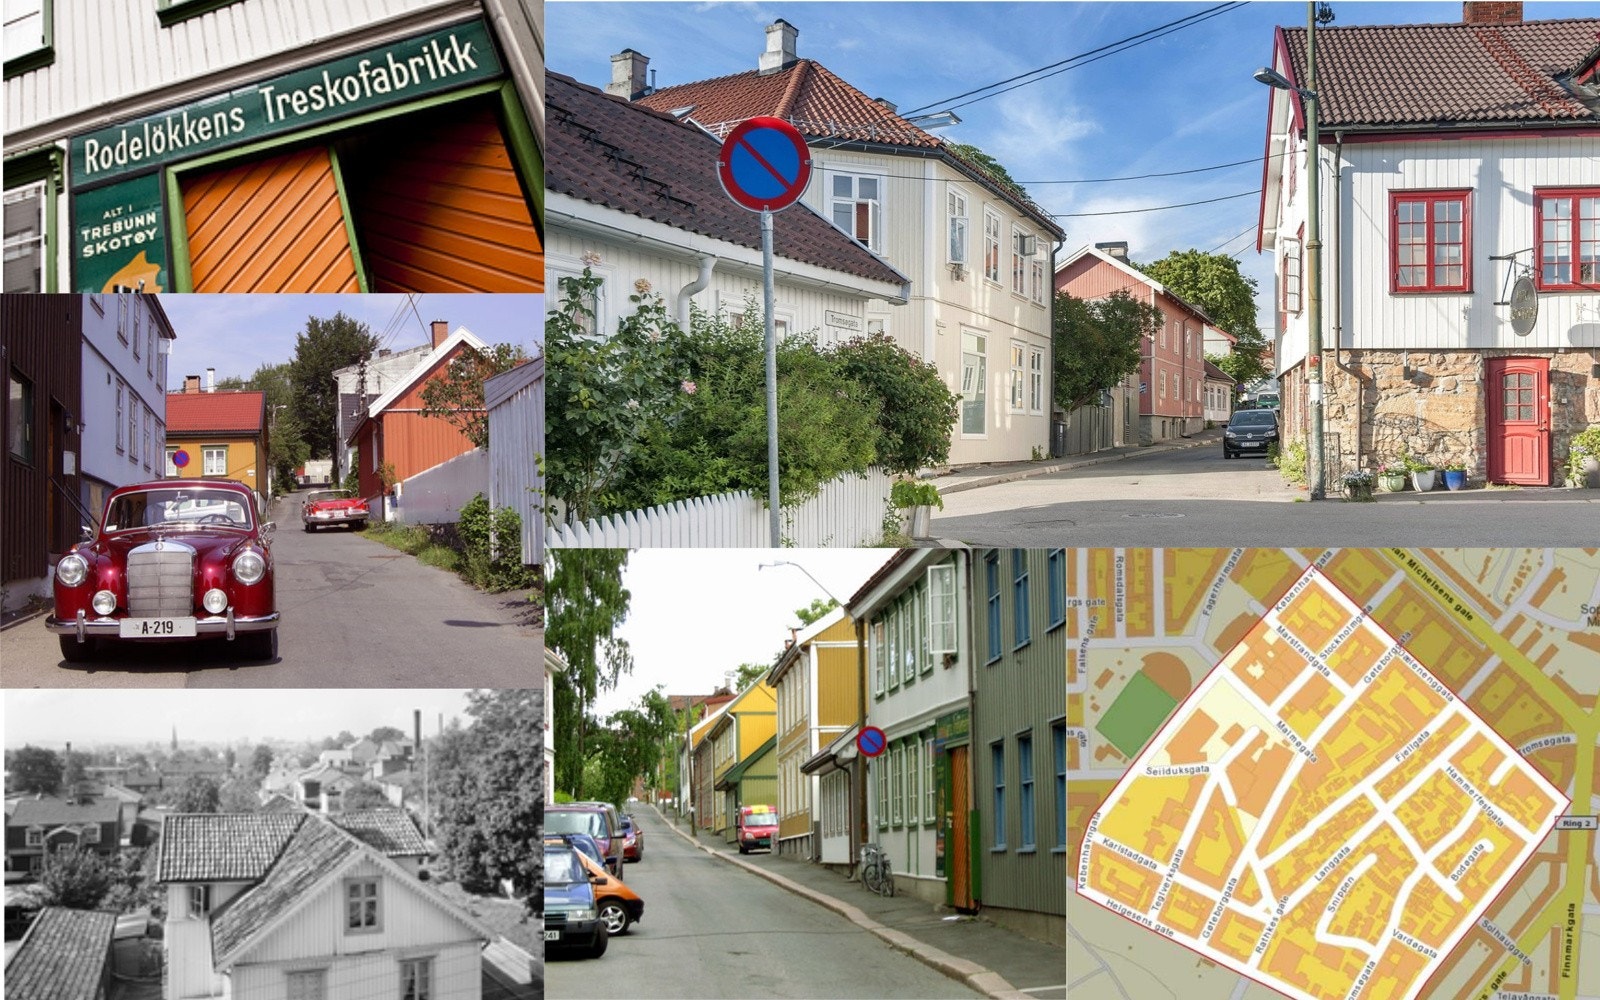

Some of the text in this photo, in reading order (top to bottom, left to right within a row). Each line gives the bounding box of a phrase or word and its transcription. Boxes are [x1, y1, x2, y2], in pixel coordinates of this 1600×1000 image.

[84, 34, 478, 175] Rodelökkens Treskofabrikk
[81, 212, 156, 241] TREBUNN
[103, 206, 123, 219] ALT
[82, 227, 157, 258] SKOTØY
[1116, 556, 1124, 622] Romsdalsgata
[1203, 547, 1243, 616] Fagerheimgata
[1407, 559, 1454, 604] Michelsens
[1454, 604, 1473, 621] gate
[1086, 598, 1106, 608] gate
[142, 620, 174, 635] A-219
[1078, 615, 1099, 673] Falsens gate
[1276, 625, 1331, 677] Marstrandgata
[1276, 720, 1317, 763] Malmøgata
[1395, 730, 1430, 762] Fjellgata
[1146, 765, 1209, 775] Seilduksgata
[1446, 766, 1504, 827] Hammerfestgata
[1563, 820, 1582, 829] Ring
[1078, 812, 1101, 889] Københavngata
[1102, 838, 1158, 870] Karlstadgata
[1314, 846, 1350, 882] Langgata
[1451, 843, 1484, 882] Bodøgata
[1152, 848, 1184, 911] Teglverksgata
[1327, 876, 1355, 913] Snippen
[1106, 899, 1174, 938] Helgesens gate
[1202, 877, 1238, 939] Gøteborggata
[1255, 895, 1289, 954] Rathkes gate
[1393, 928, 1438, 959] Vardøgata
[1481, 918, 1531, 966] Solhauggata
[1562, 903, 1576, 978] Finnmarkgata
[1491, 971, 1507, 991] gate
